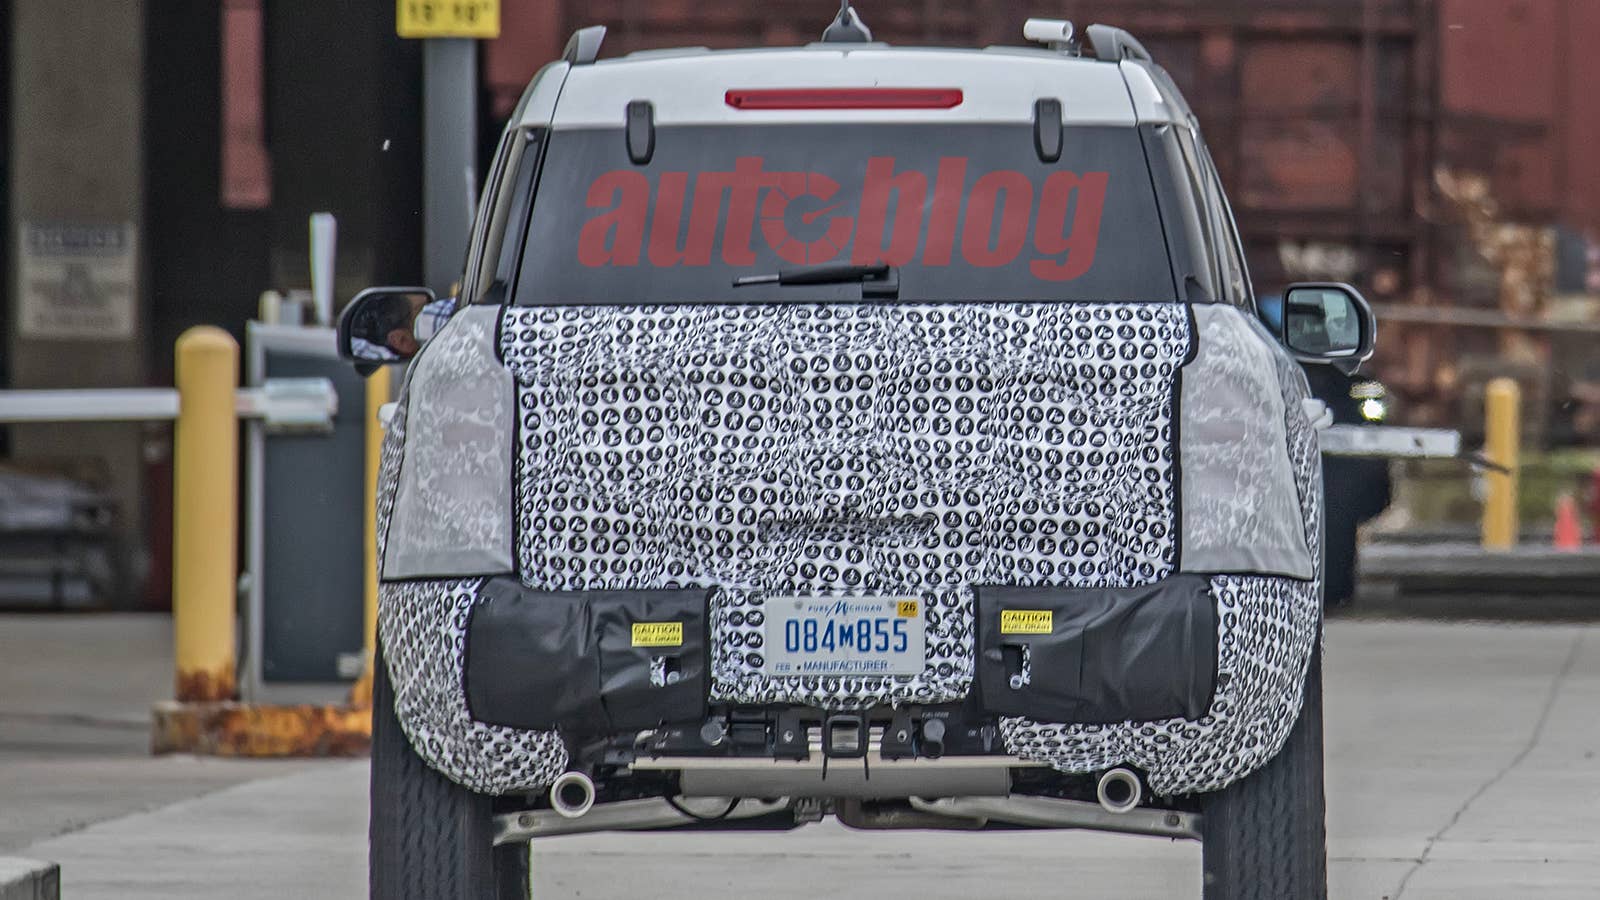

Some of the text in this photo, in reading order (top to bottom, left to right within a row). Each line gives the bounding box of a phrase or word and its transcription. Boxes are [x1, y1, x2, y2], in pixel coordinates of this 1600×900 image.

[902, 602, 916, 612] 26
[1003, 612, 1051, 622] CAUTION
[634, 624, 680, 634] CAUTION
[785, 618, 908, 653] 084M855
[775, 663, 791, 672] FEB
[803, 660, 889, 673] MANUFACTURER
